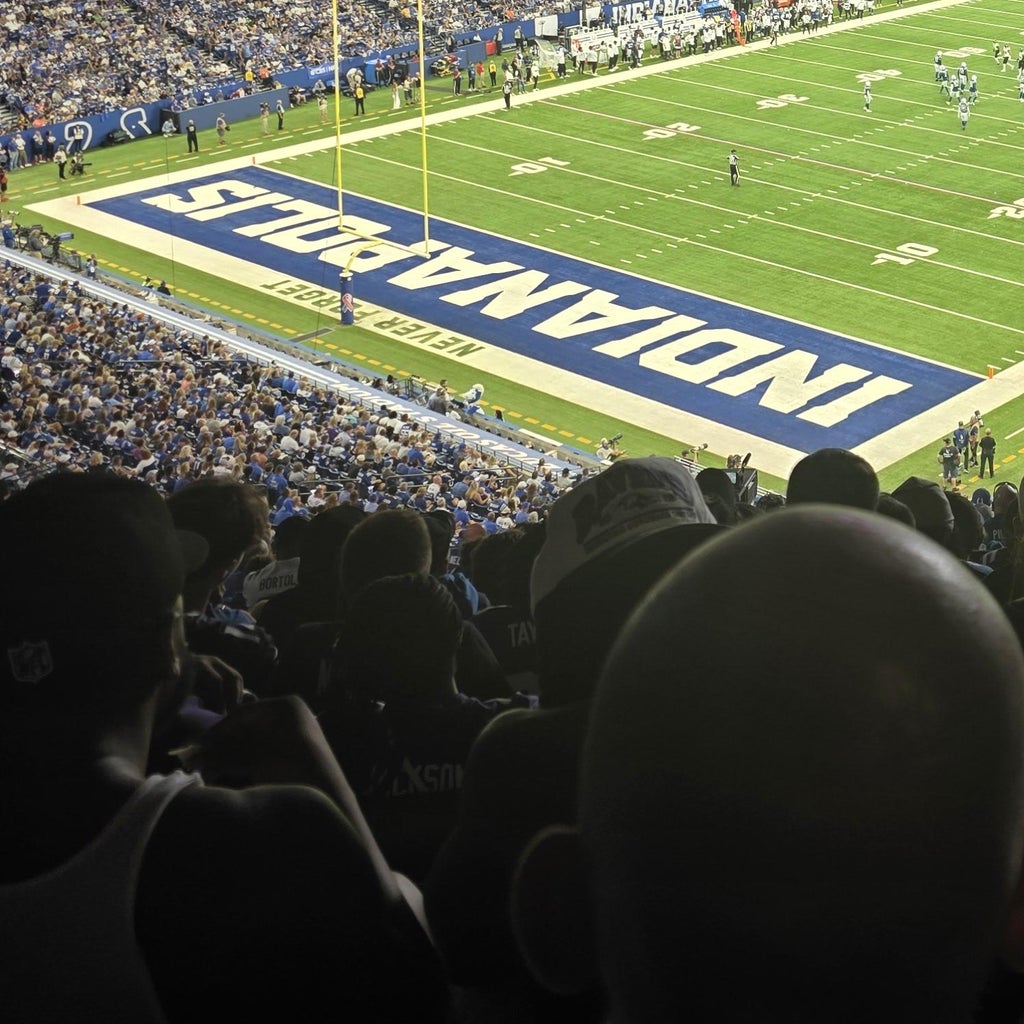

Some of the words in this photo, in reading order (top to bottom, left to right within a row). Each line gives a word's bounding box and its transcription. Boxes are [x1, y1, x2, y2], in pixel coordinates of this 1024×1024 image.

[642, 122, 701, 141] 20
[508, 157, 571, 176] 10
[871, 242, 939, 266] 10
[140, 179, 913, 428] INDIANAPOLIS
[374, 316, 486, 357] NEVER
